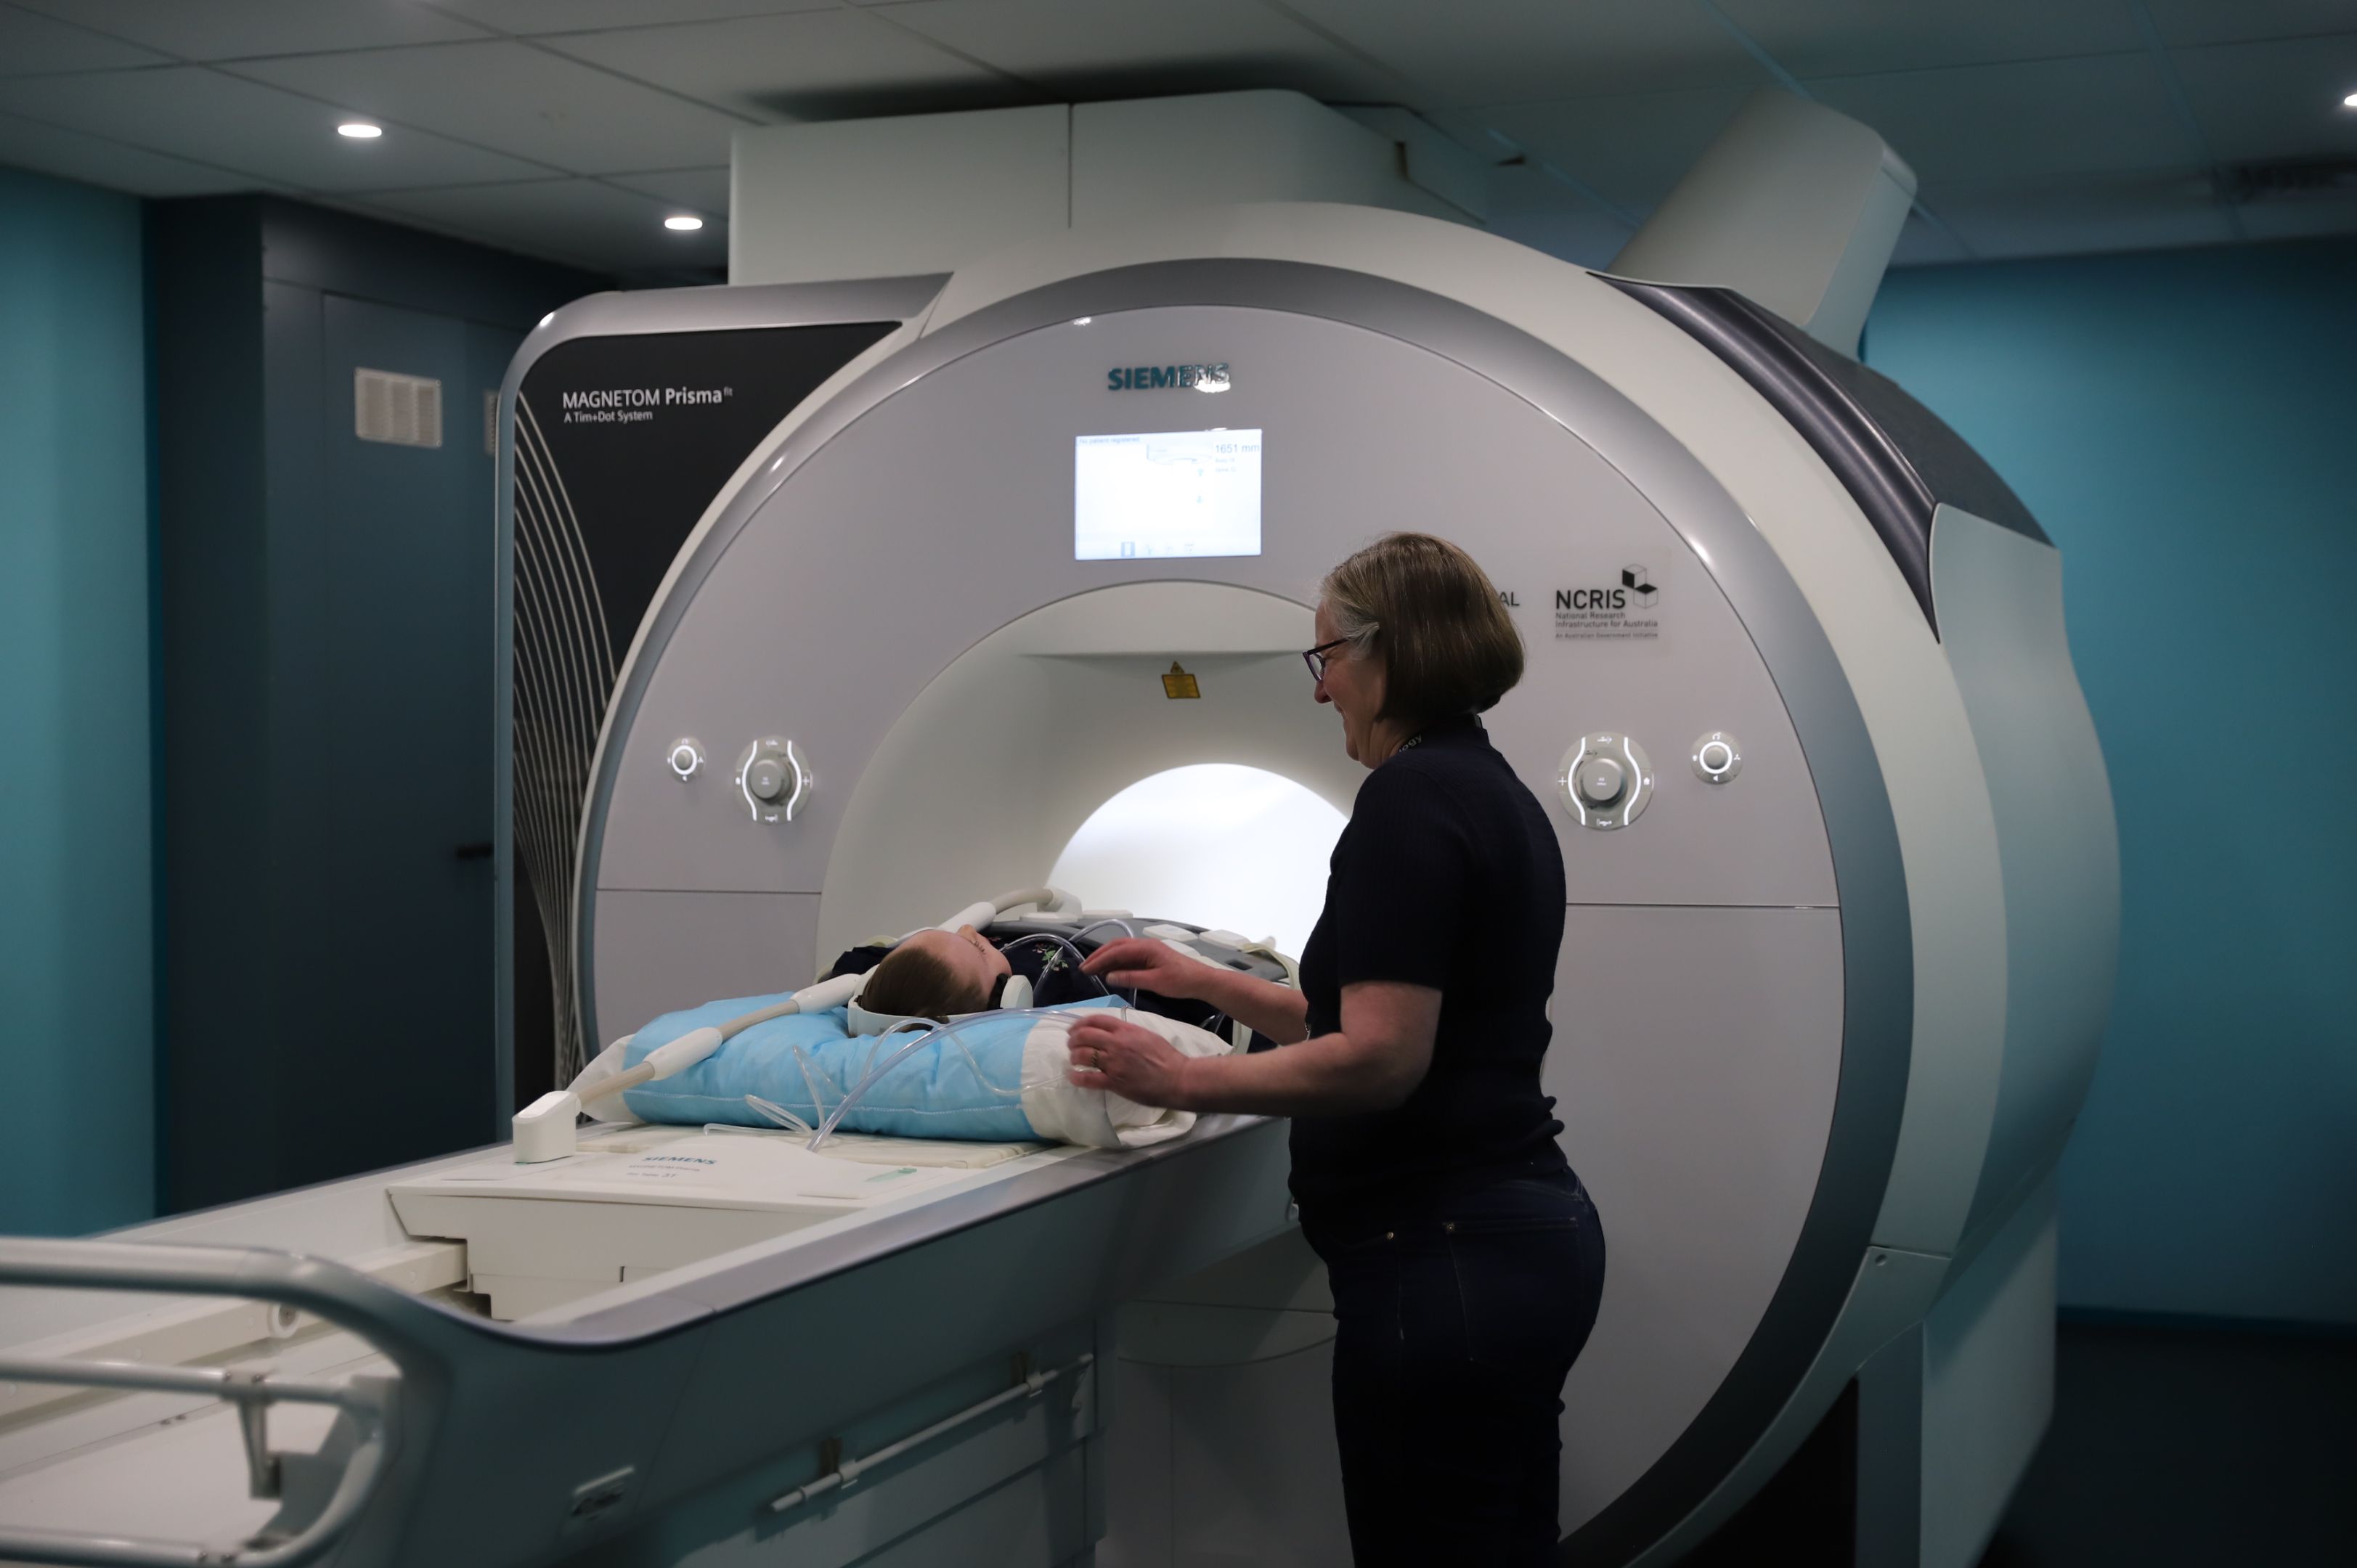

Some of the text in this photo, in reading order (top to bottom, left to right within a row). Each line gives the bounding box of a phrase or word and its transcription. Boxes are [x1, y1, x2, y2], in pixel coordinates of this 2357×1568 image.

[1107, 363, 1230, 391] SIEMENS
[562, 388, 660, 409] MAGNETOM
[563, 409, 653, 424] A Tim+Dot System
[1215, 444, 1261, 454] 1651 mm
[1498, 591, 1521, 608] AL
[1555, 589, 1626, 610] NCRIS
[1555, 611, 1588, 620] National
[1623, 619, 1658, 628] Australia
[641, 1156, 717, 1165] SIEMENS
